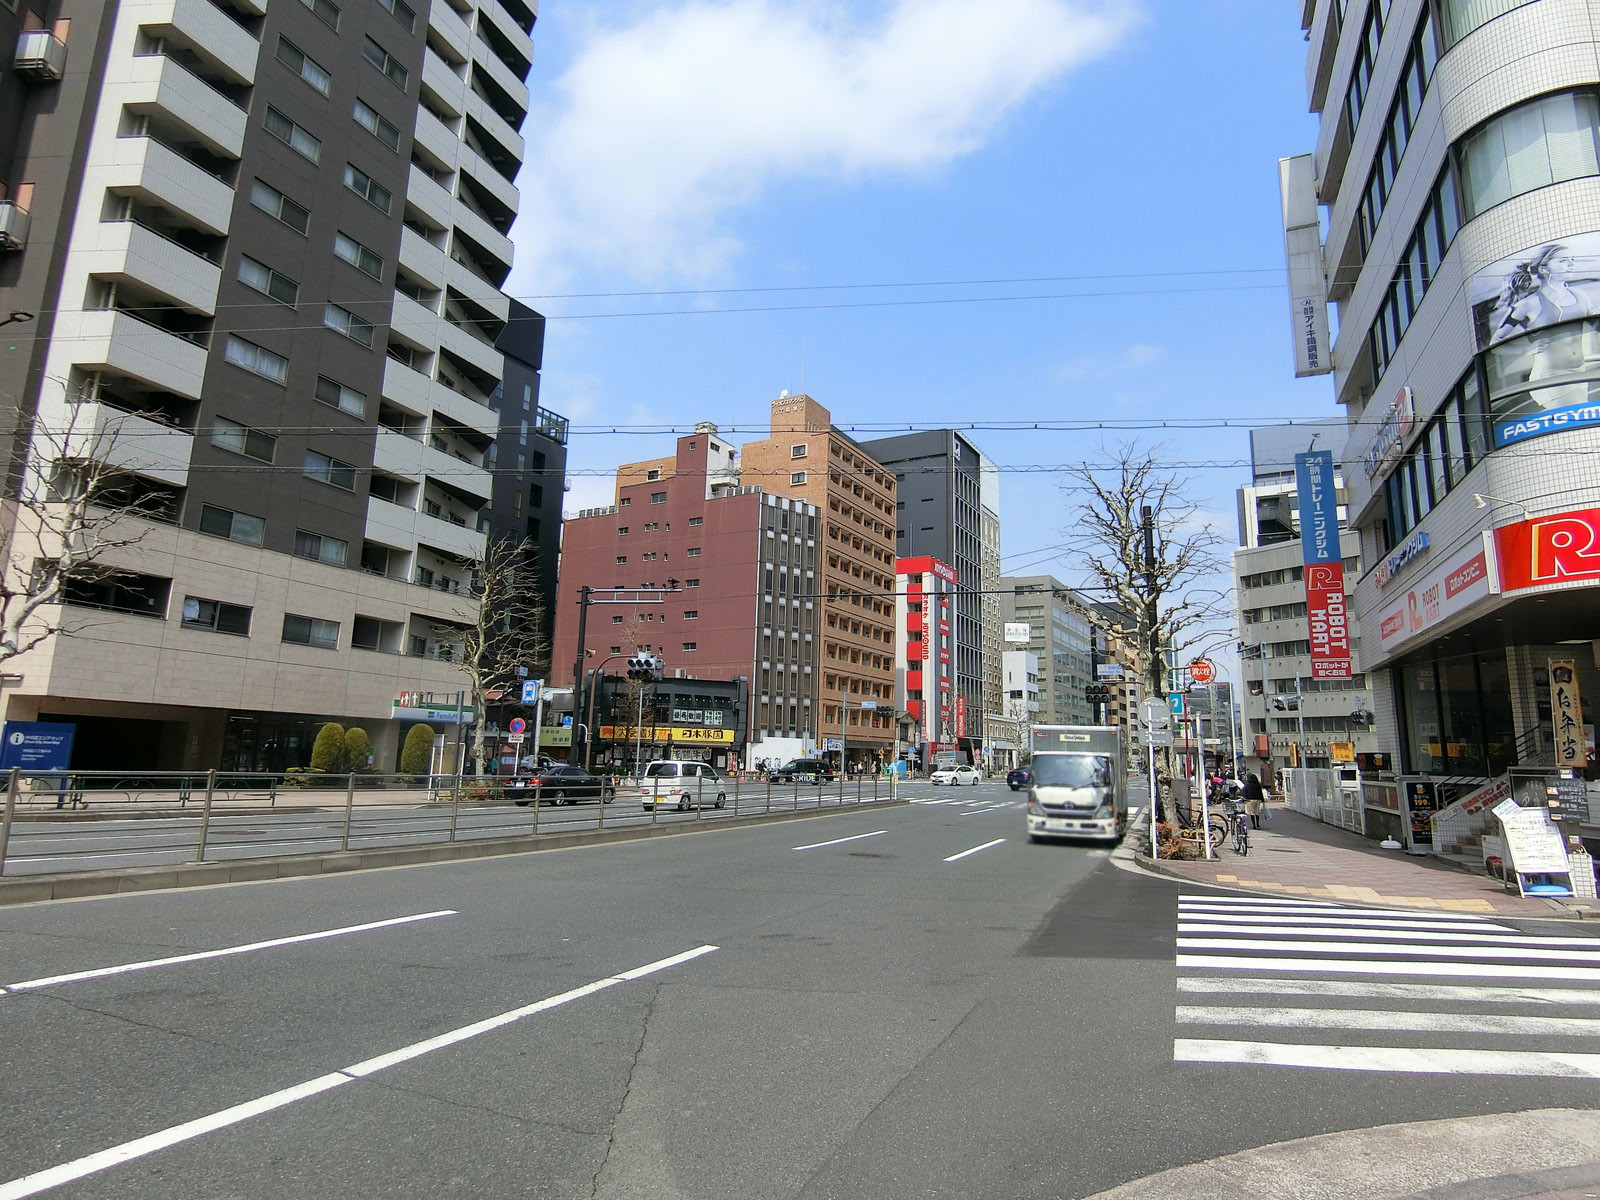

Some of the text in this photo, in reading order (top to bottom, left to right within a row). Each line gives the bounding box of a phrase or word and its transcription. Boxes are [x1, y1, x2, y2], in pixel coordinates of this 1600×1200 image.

[1422, 583, 1440, 608] ROBOT
[1310, 609, 1330, 655] MART
[1326, 592, 1346, 649] ROBOT
